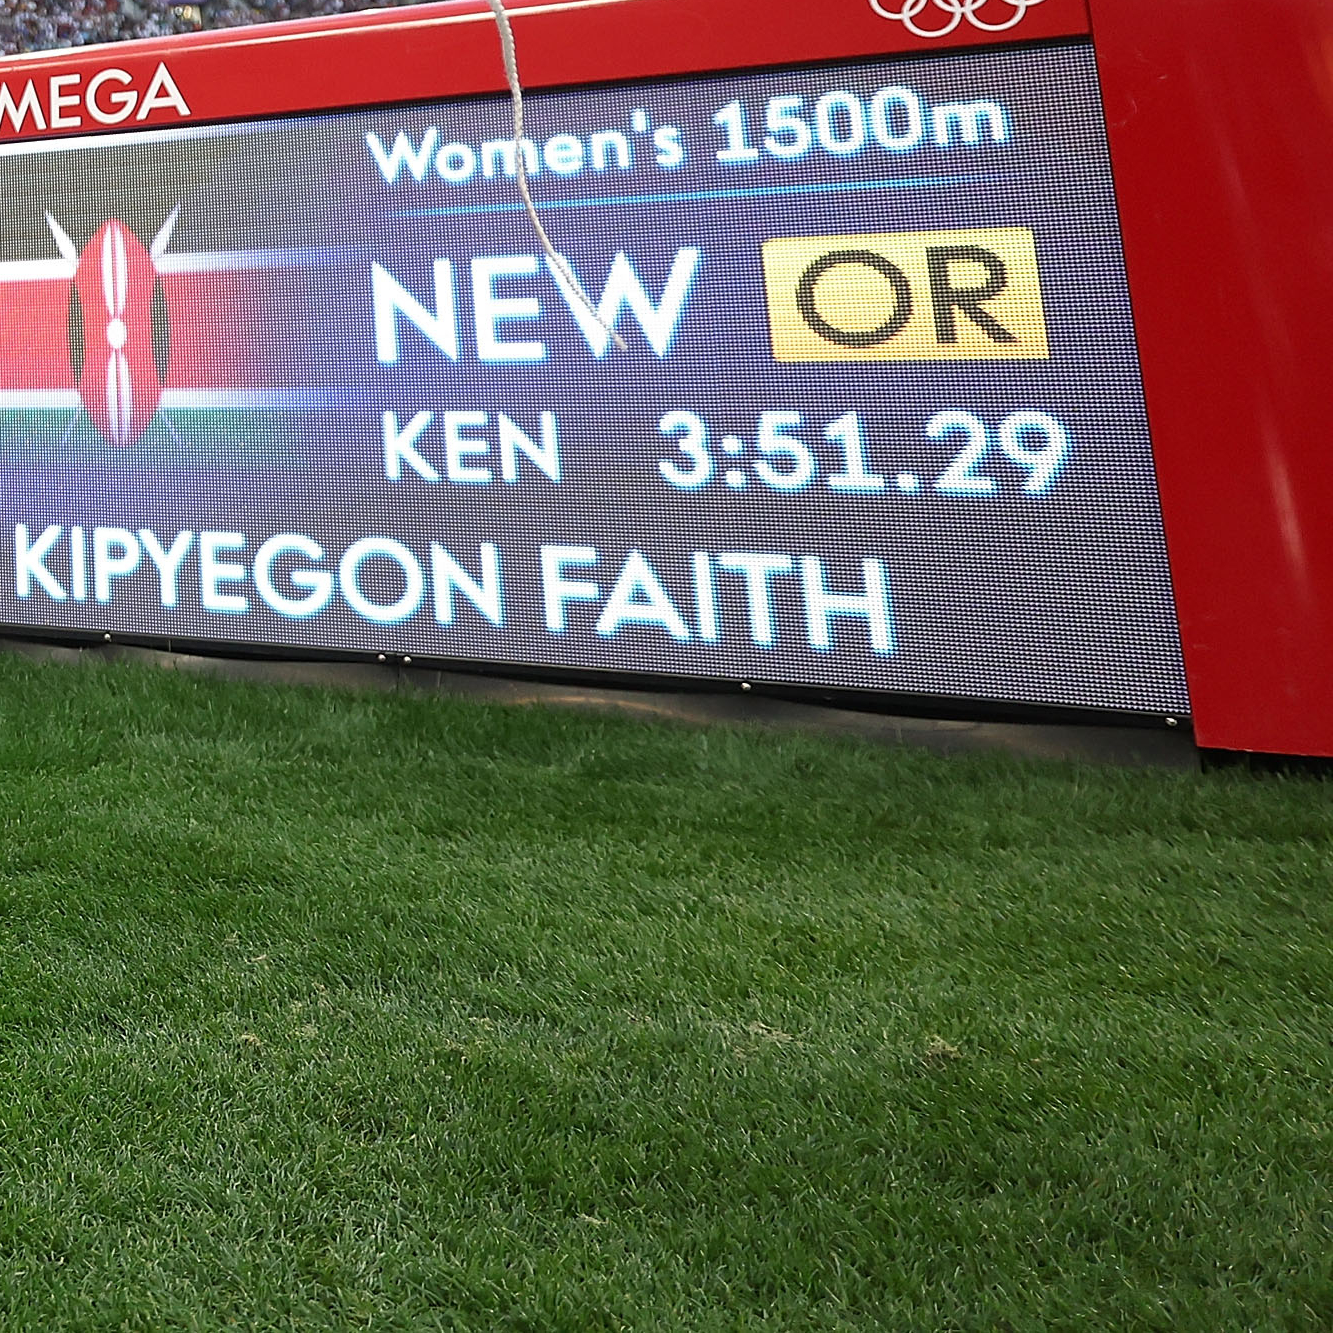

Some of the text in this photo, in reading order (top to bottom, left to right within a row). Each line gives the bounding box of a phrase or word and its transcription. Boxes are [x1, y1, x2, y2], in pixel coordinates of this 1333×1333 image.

[365, 85, 1013, 187] Women's 1500m
[372, 245, 1021, 365] NEW OR
[381, 409, 1073, 498] KEN 3:51.29
[14, 522, 897, 657] KIPYEGON FAITH
